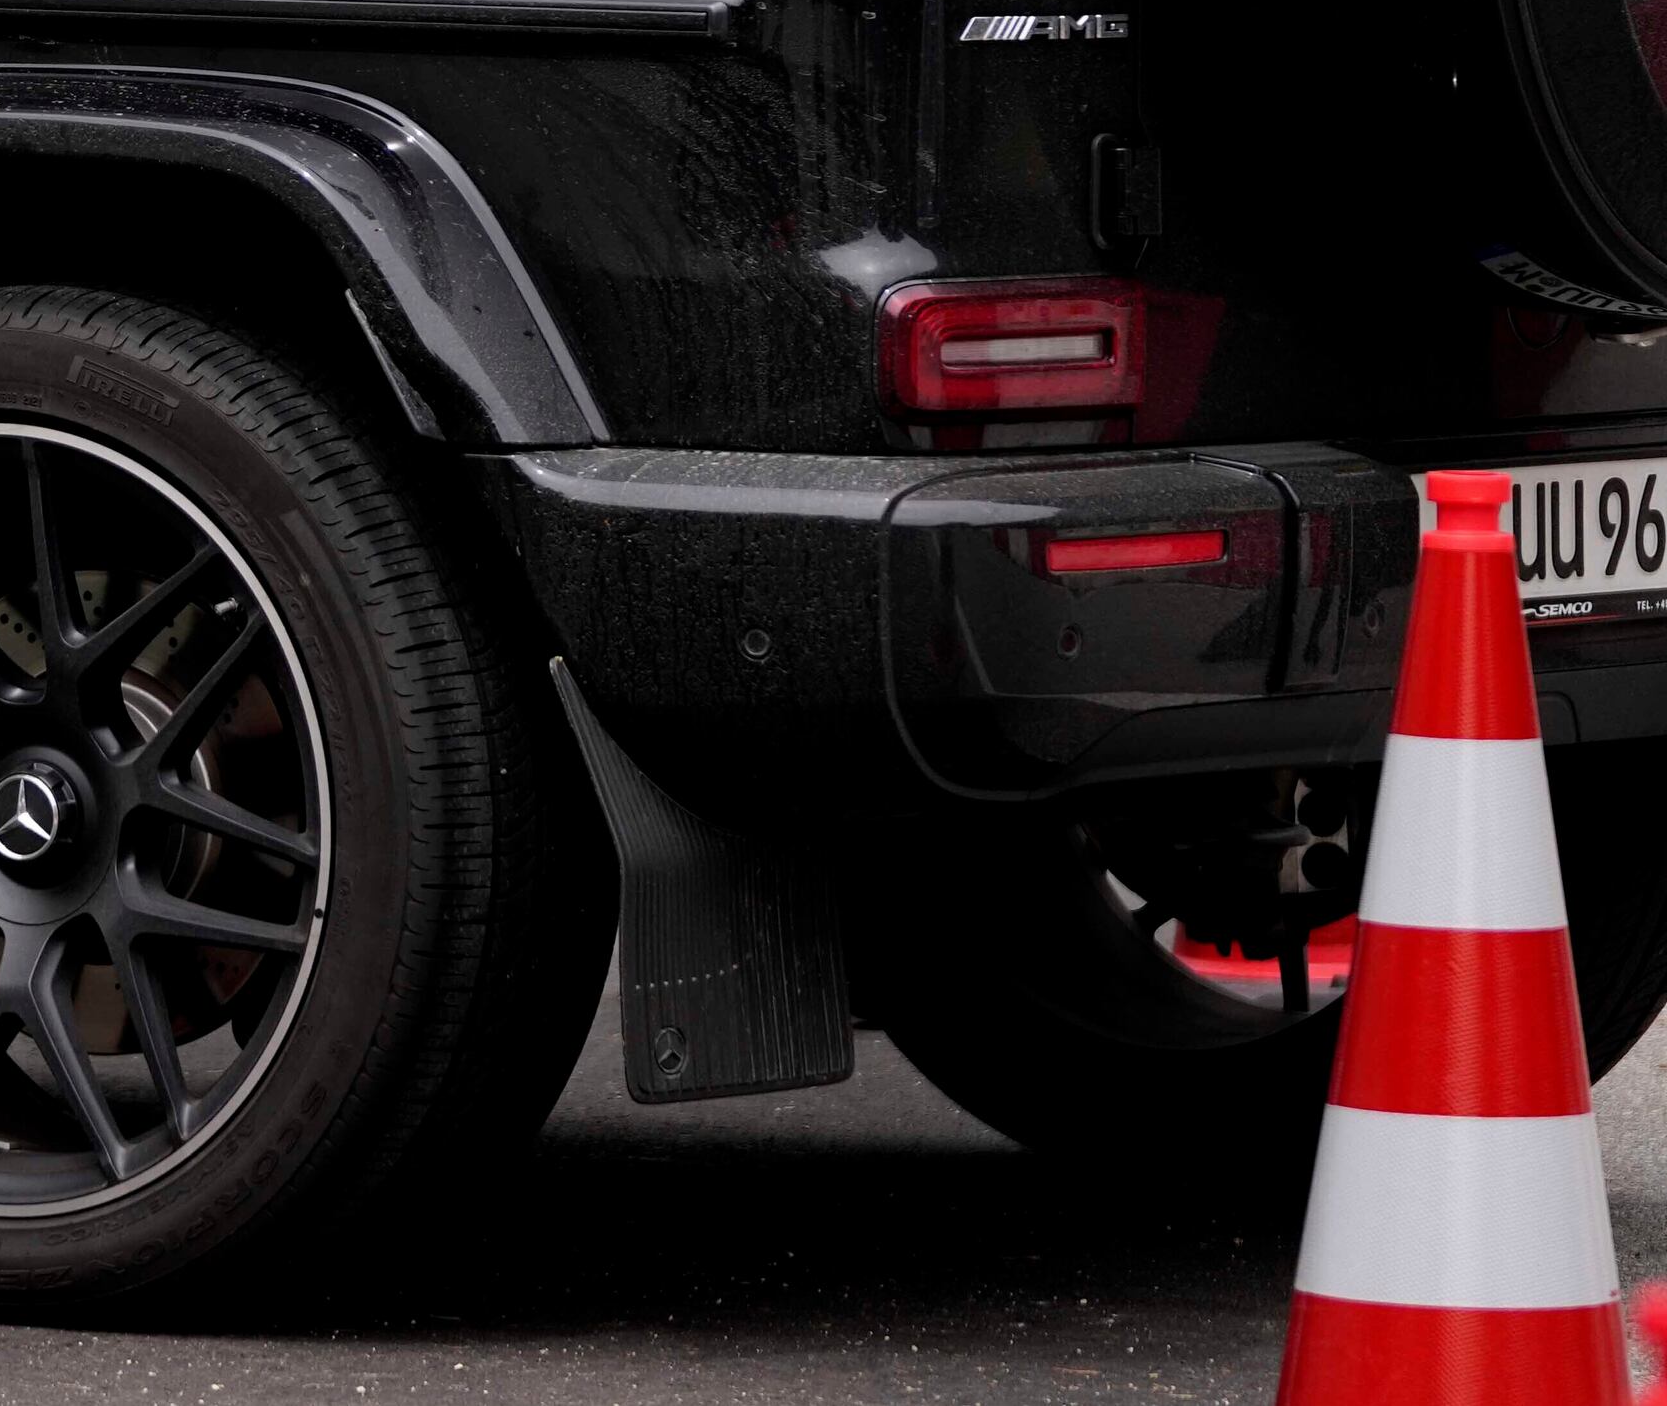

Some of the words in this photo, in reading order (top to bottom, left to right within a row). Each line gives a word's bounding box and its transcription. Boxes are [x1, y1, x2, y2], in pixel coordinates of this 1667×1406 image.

[1019, 14, 1129, 40] AMG
[66, 355, 179, 427] PIRELLI
[1513, 479, 1584, 582] UU
[1599, 474, 1666, 576] 96
[1534, 601, 1593, 618] SEMCO
